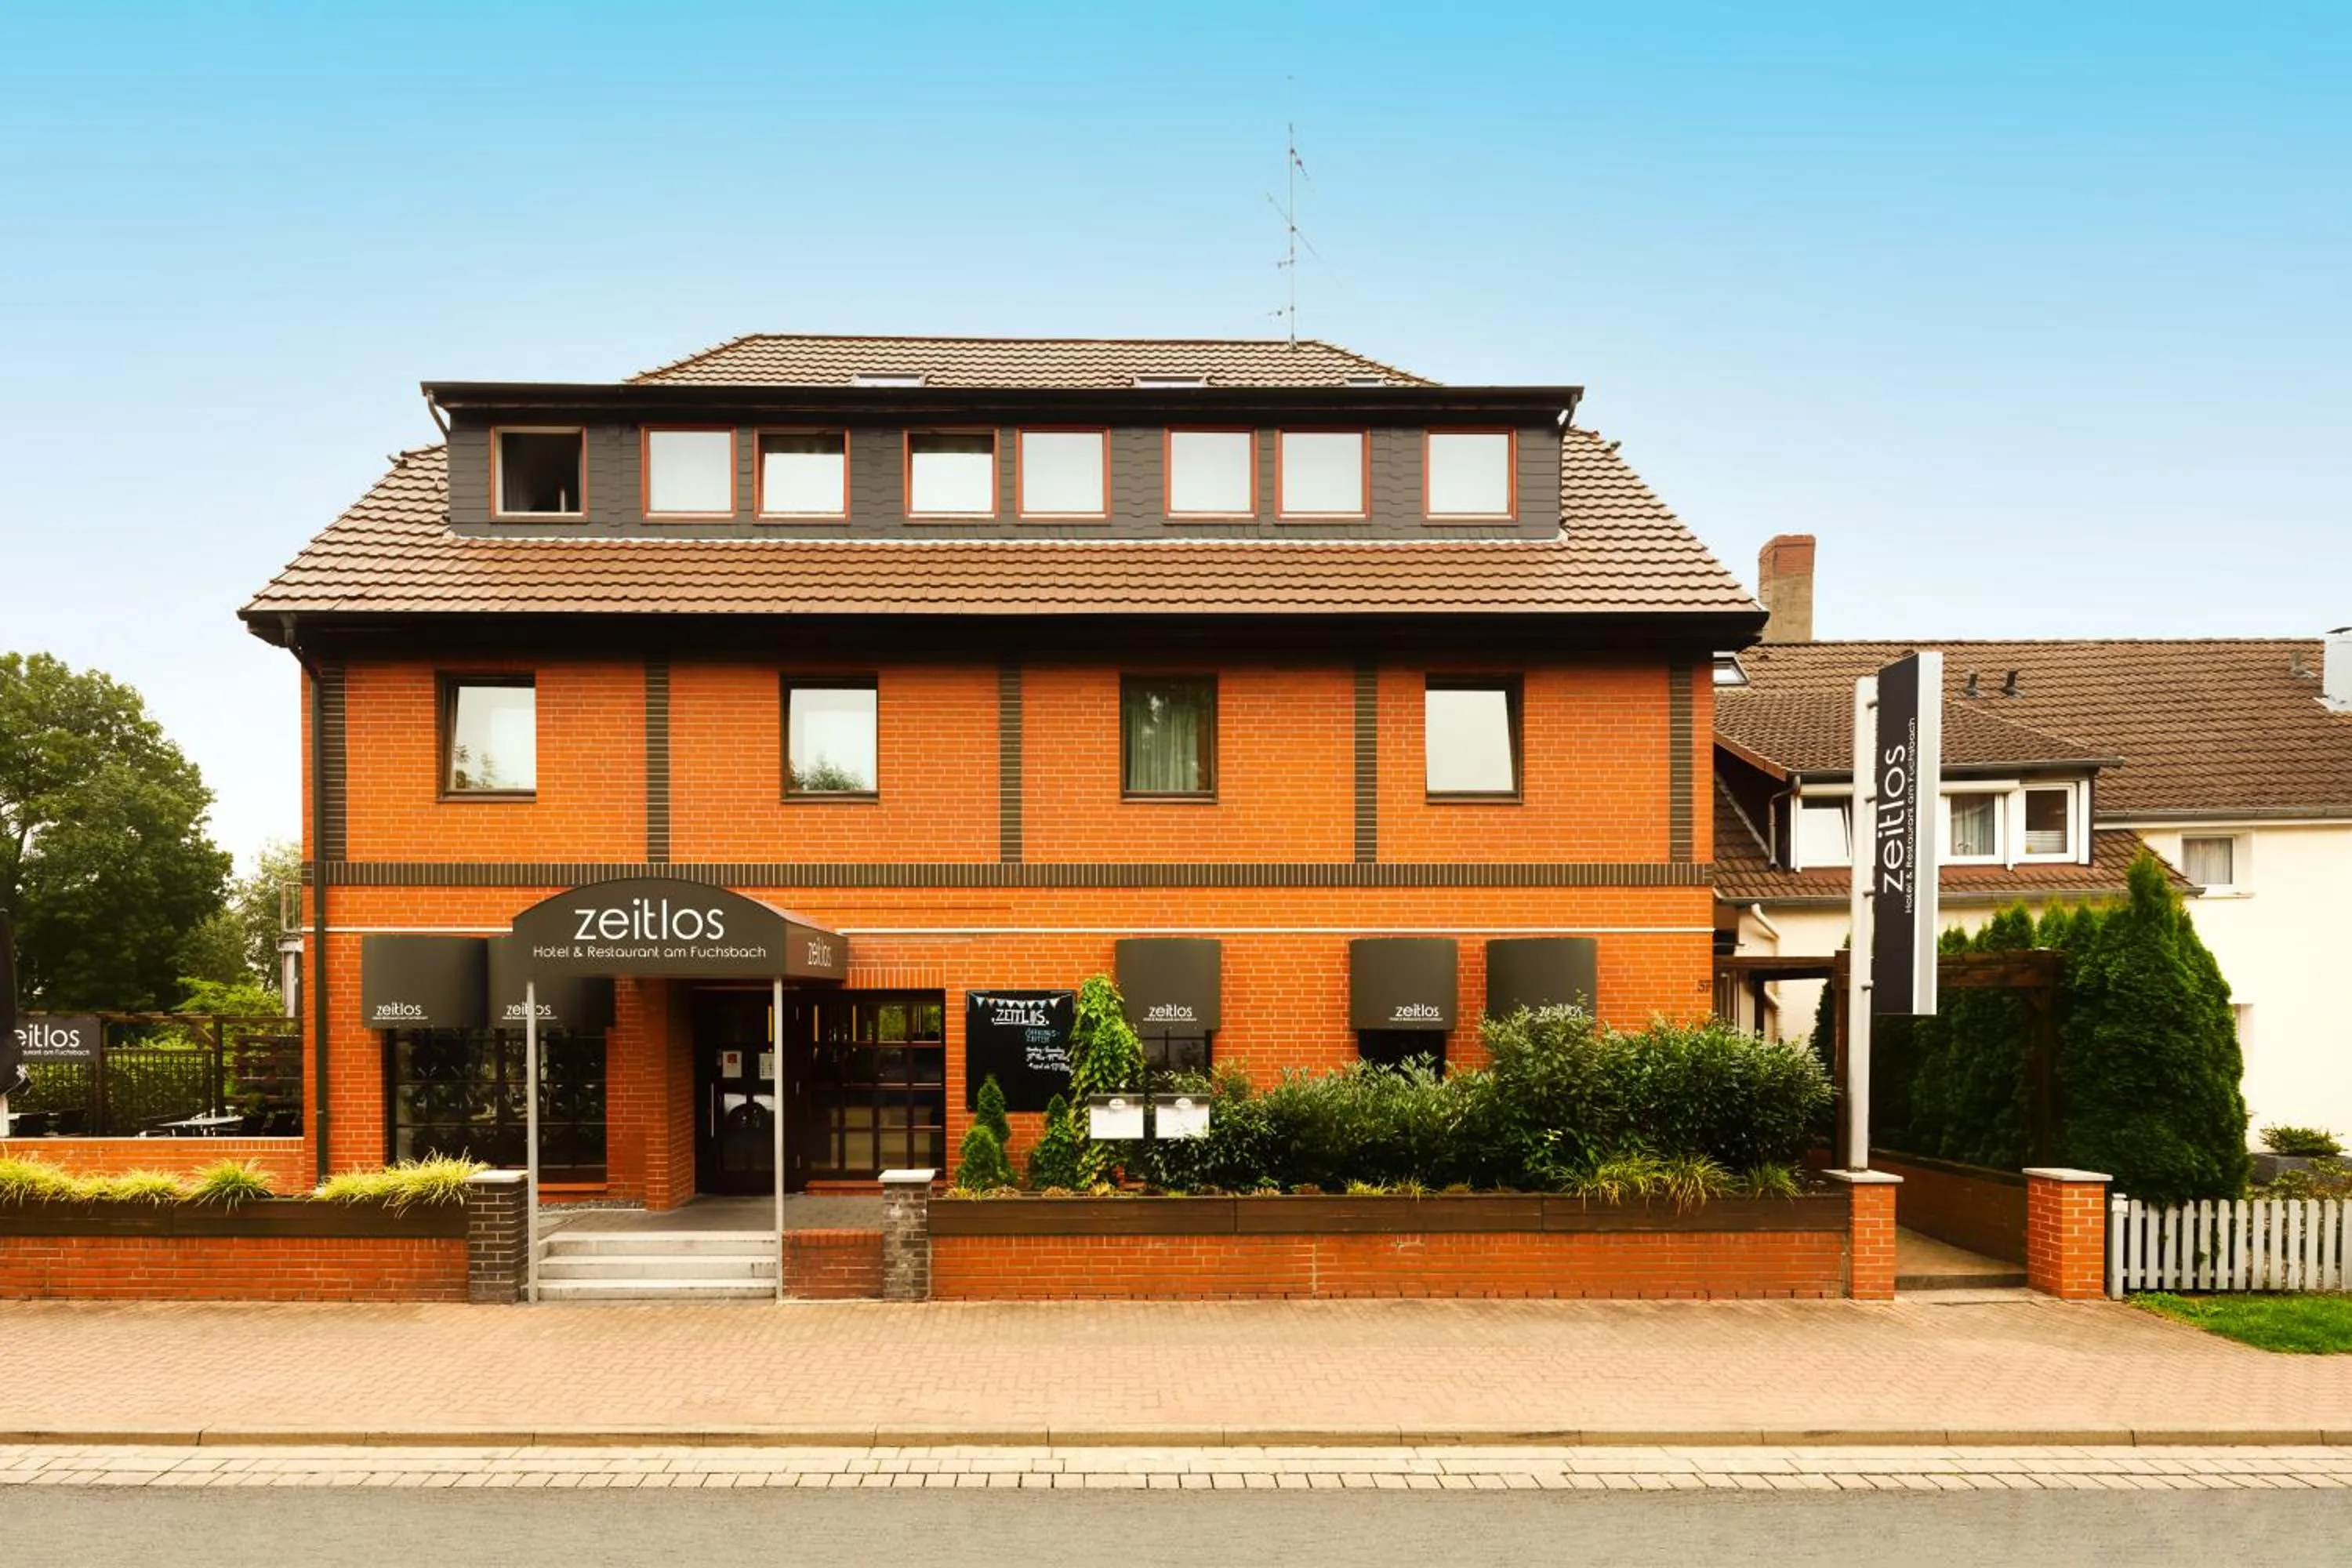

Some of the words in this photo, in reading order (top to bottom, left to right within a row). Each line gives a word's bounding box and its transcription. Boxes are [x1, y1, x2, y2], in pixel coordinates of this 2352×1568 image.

[1907, 784, 1915, 804] am
[1878, 745, 1906, 894] zeitlos
[574, 898, 724, 940] zeitlos
[533, 946, 569, 957] Hotel
[573, 946, 583, 957] &
[587, 946, 659, 957] Restaurant
[664, 947, 687, 957] am
[690, 946, 766, 957] Fuchsbach
[808, 937, 832, 967] zeitlos
[376, 1001, 422, 1015] zeitlos
[1149, 1003, 1192, 1017] zeitlos
[1395, 1004, 1439, 1017] zeitlos
[13, 1024, 80, 1047] eitlos
